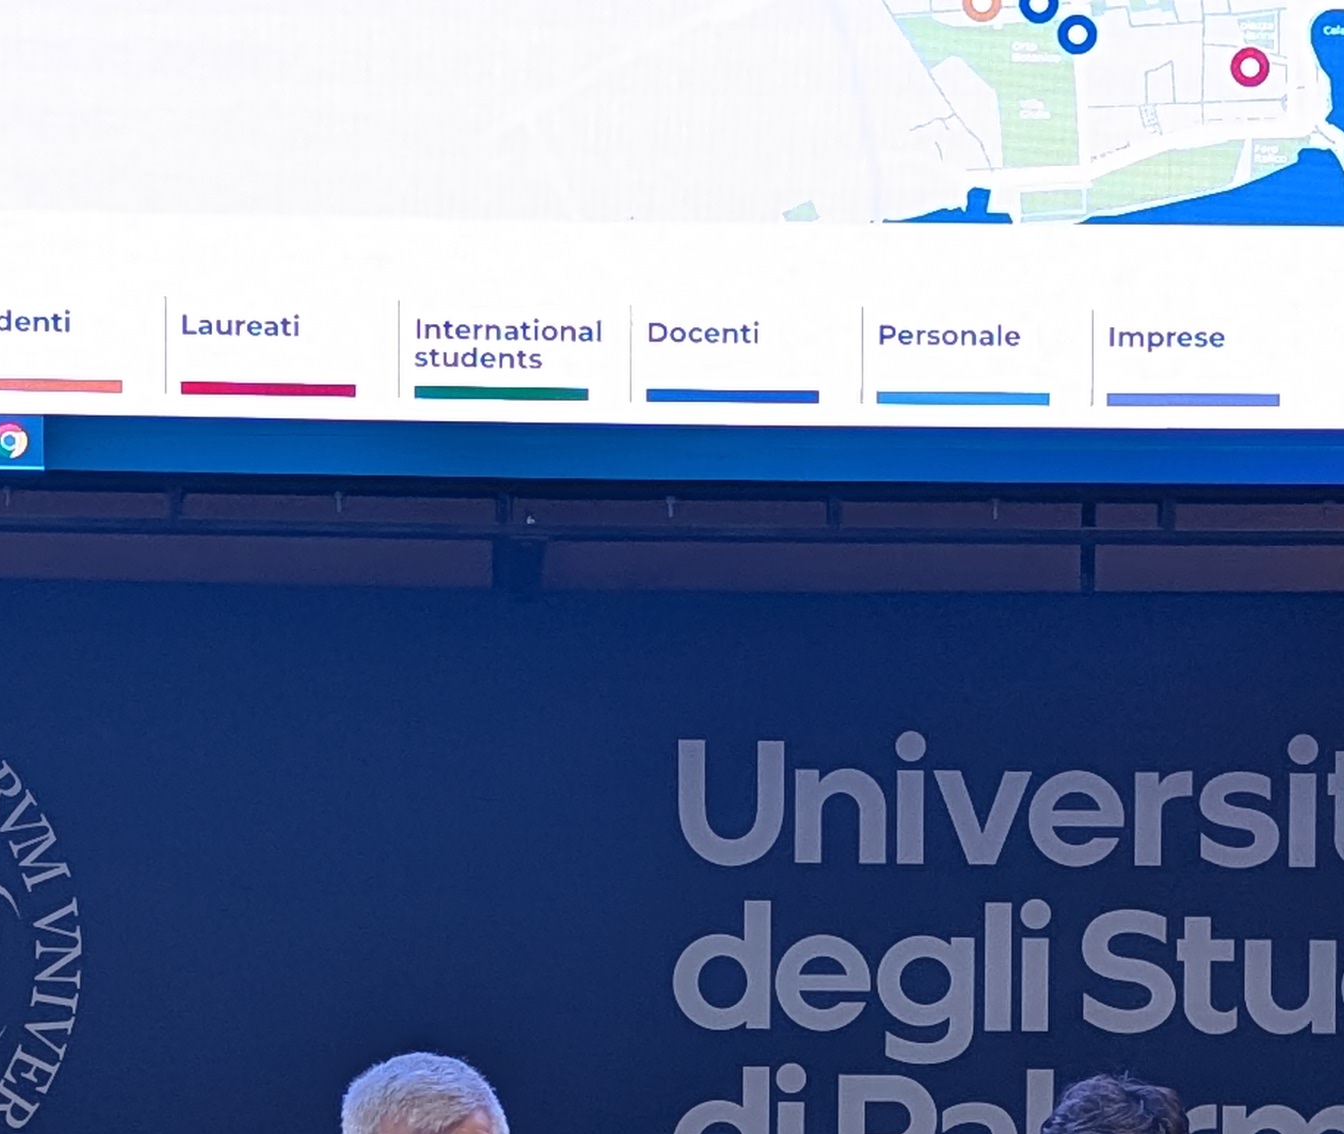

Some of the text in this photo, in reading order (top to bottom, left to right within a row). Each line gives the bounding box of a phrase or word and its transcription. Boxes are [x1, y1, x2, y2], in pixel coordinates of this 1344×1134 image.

[181, 313, 301, 338] Laureati
[415, 318, 603, 344] International
[647, 320, 761, 345] Docenti
[878, 324, 1022, 348] Personale
[1109, 326, 1226, 353] Imprese
[414, 346, 543, 370] students
[672, 898, 1052, 1065] degli
